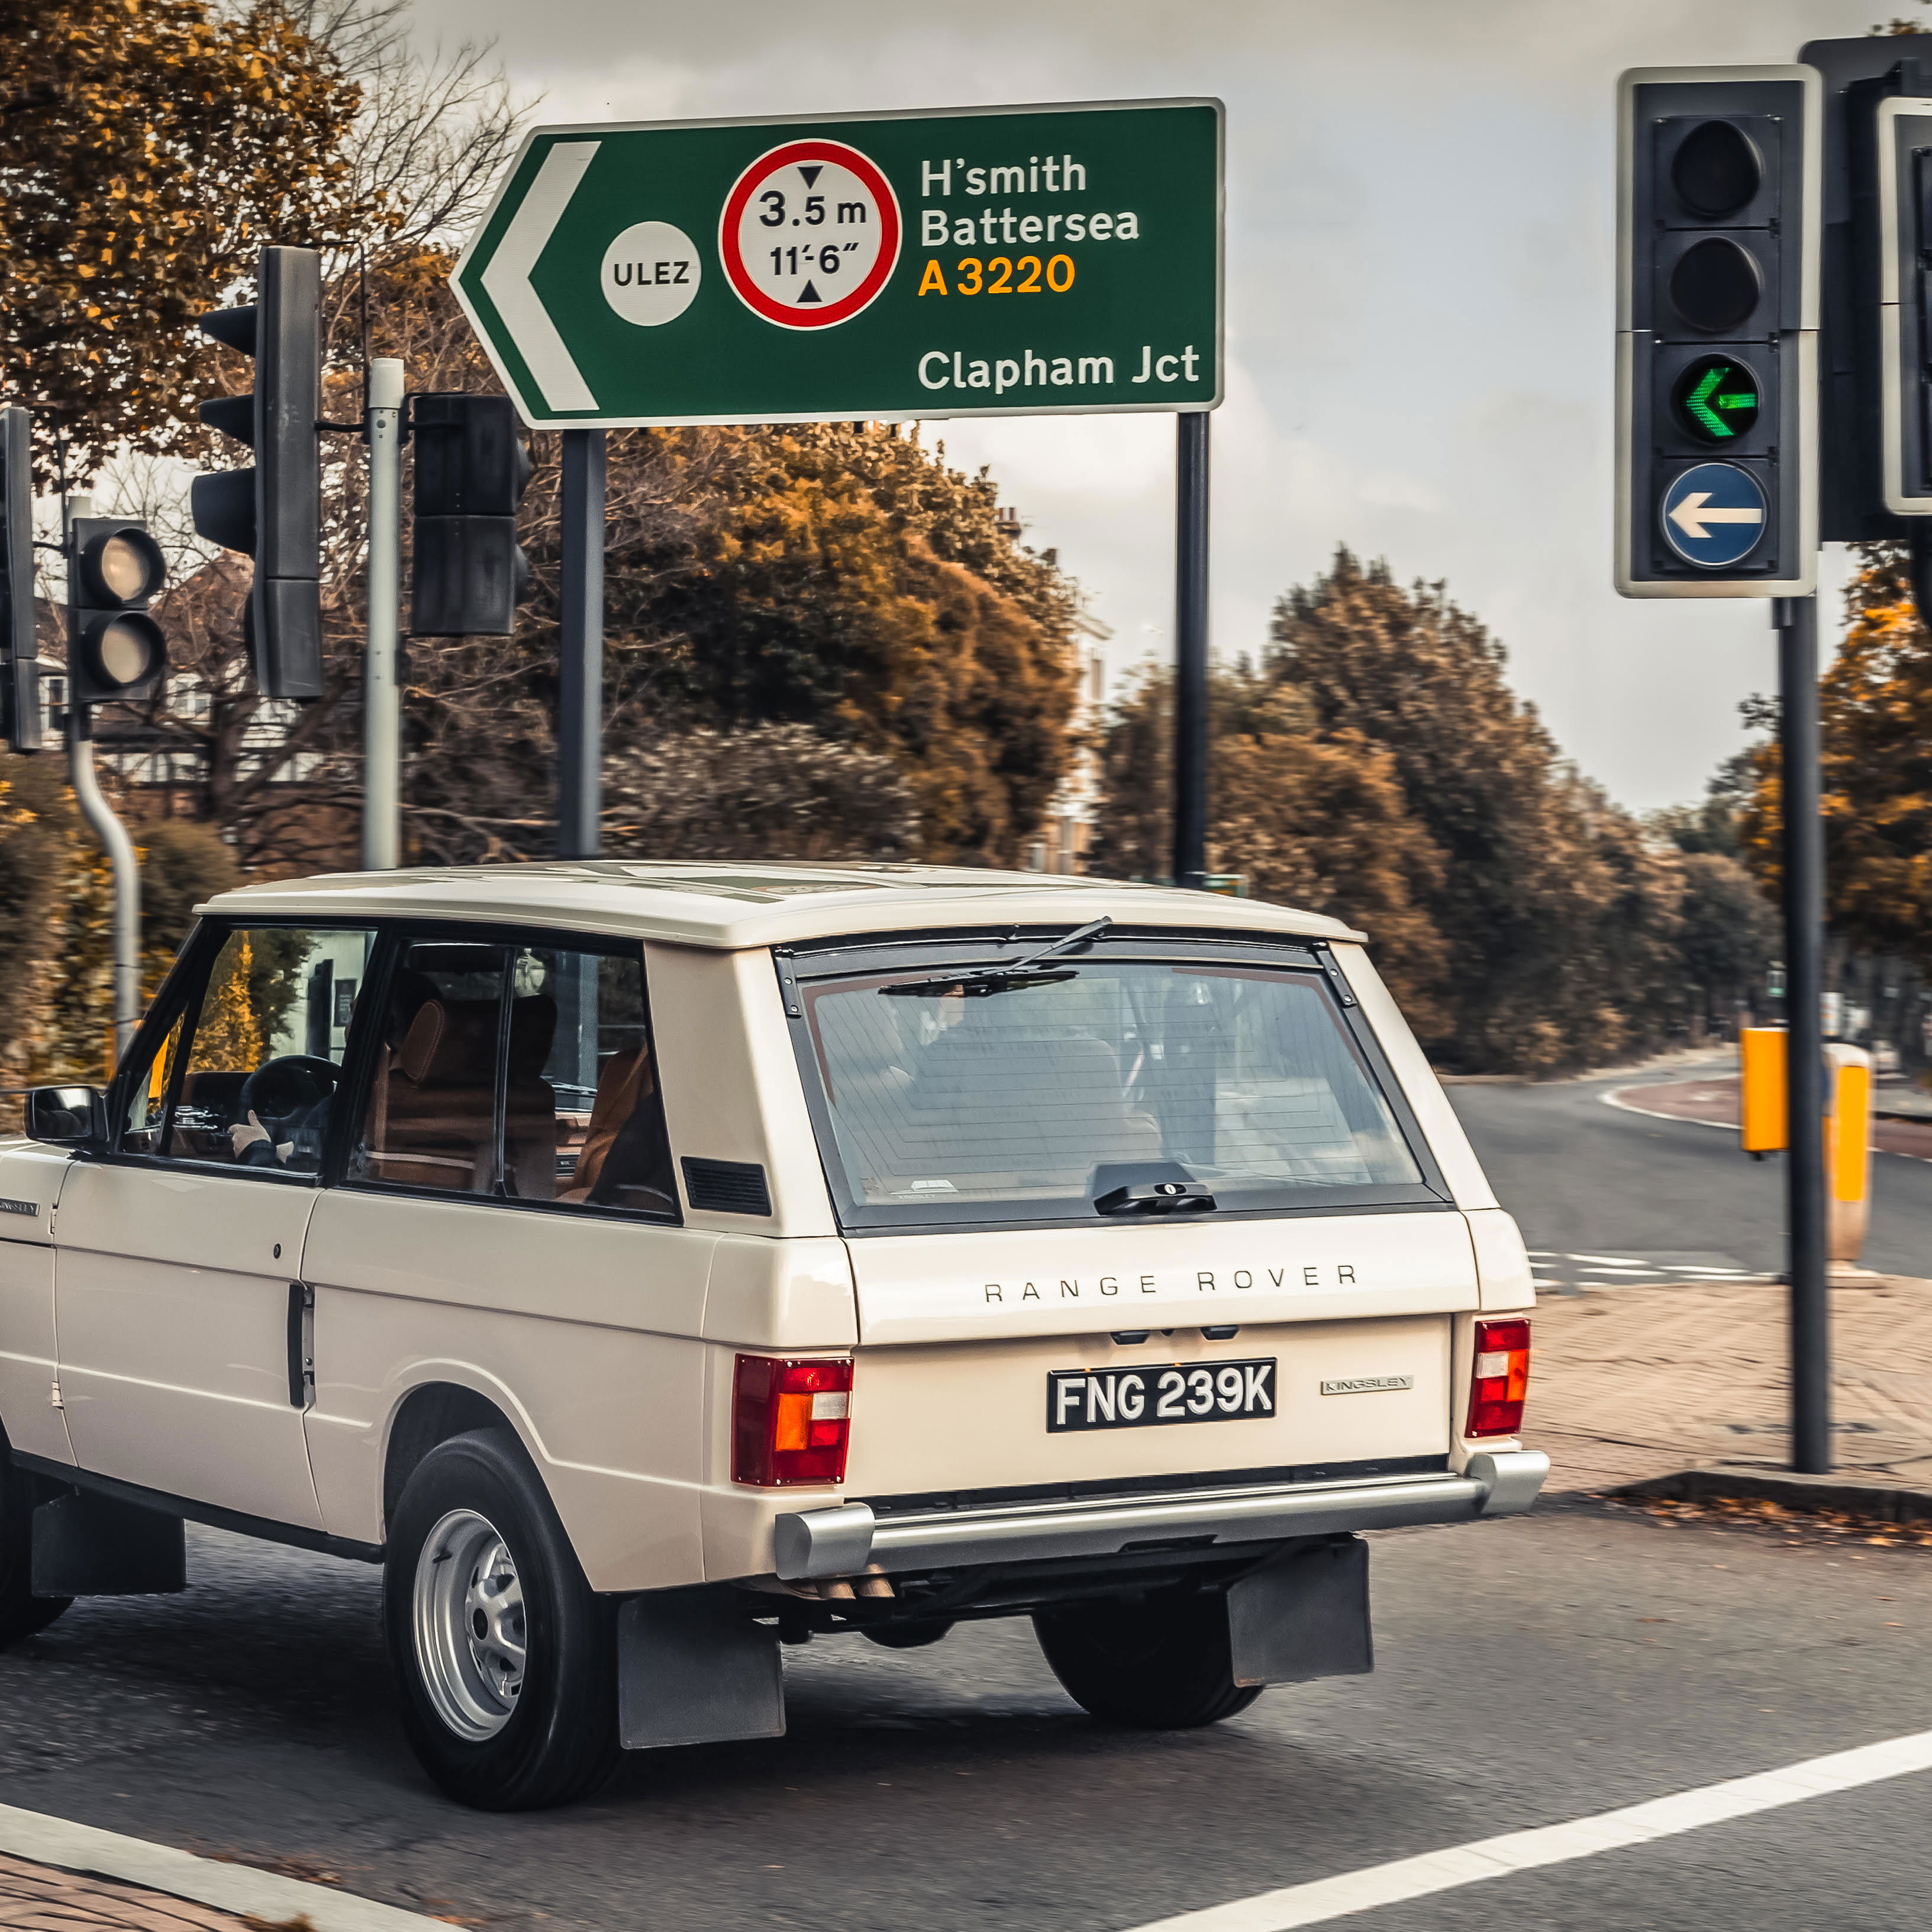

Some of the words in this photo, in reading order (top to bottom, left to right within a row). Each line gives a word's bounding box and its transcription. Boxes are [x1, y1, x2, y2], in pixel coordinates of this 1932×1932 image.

[759, 190, 825, 227] 3.5
[837, 202, 866, 224] m
[921, 207, 1140, 247] Battersea
[614, 261, 690, 286] ULEZ
[957, 254, 1076, 295] 3220
[918, 349, 1114, 395] Clapham
[1131, 345, 1200, 383] Jct
[985, 1275, 1156, 1303] RANGE
[1197, 1265, 1356, 1292] ROVER
[1056, 1372, 1145, 1425] FNG
[1156, 1365, 1273, 1418] 239K
[1325, 1376, 1411, 1391] KINGSLEY
